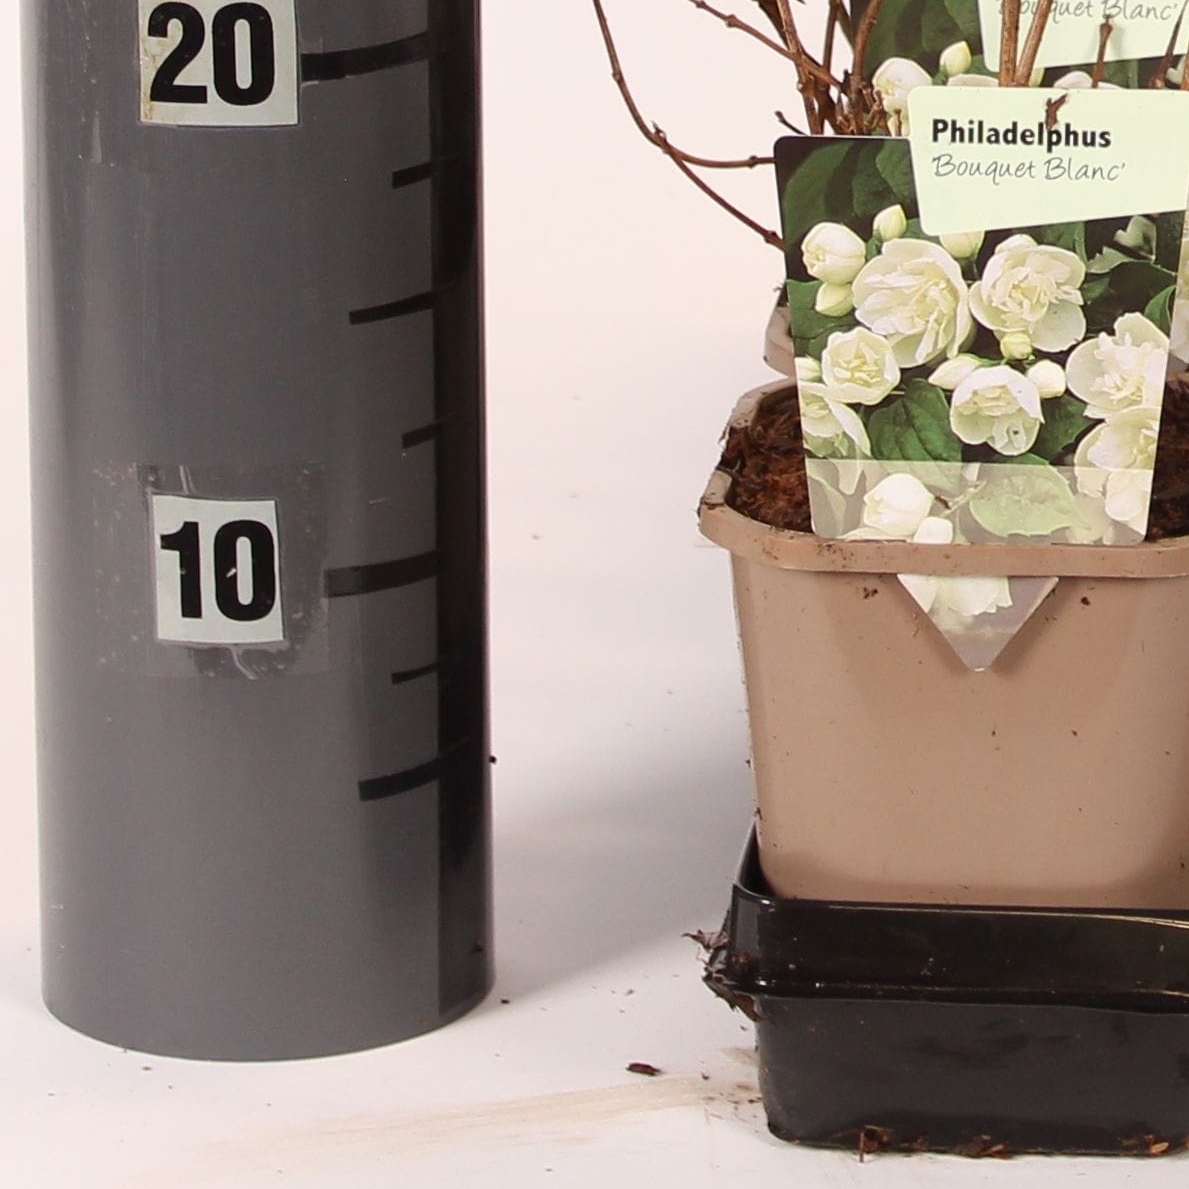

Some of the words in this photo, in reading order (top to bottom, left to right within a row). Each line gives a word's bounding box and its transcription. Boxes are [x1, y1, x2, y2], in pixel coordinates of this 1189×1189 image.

[146, 1, 276, 106] 20
[932, 118, 1112, 154] Philadelphus
[159, 520, 276, 620] 10
